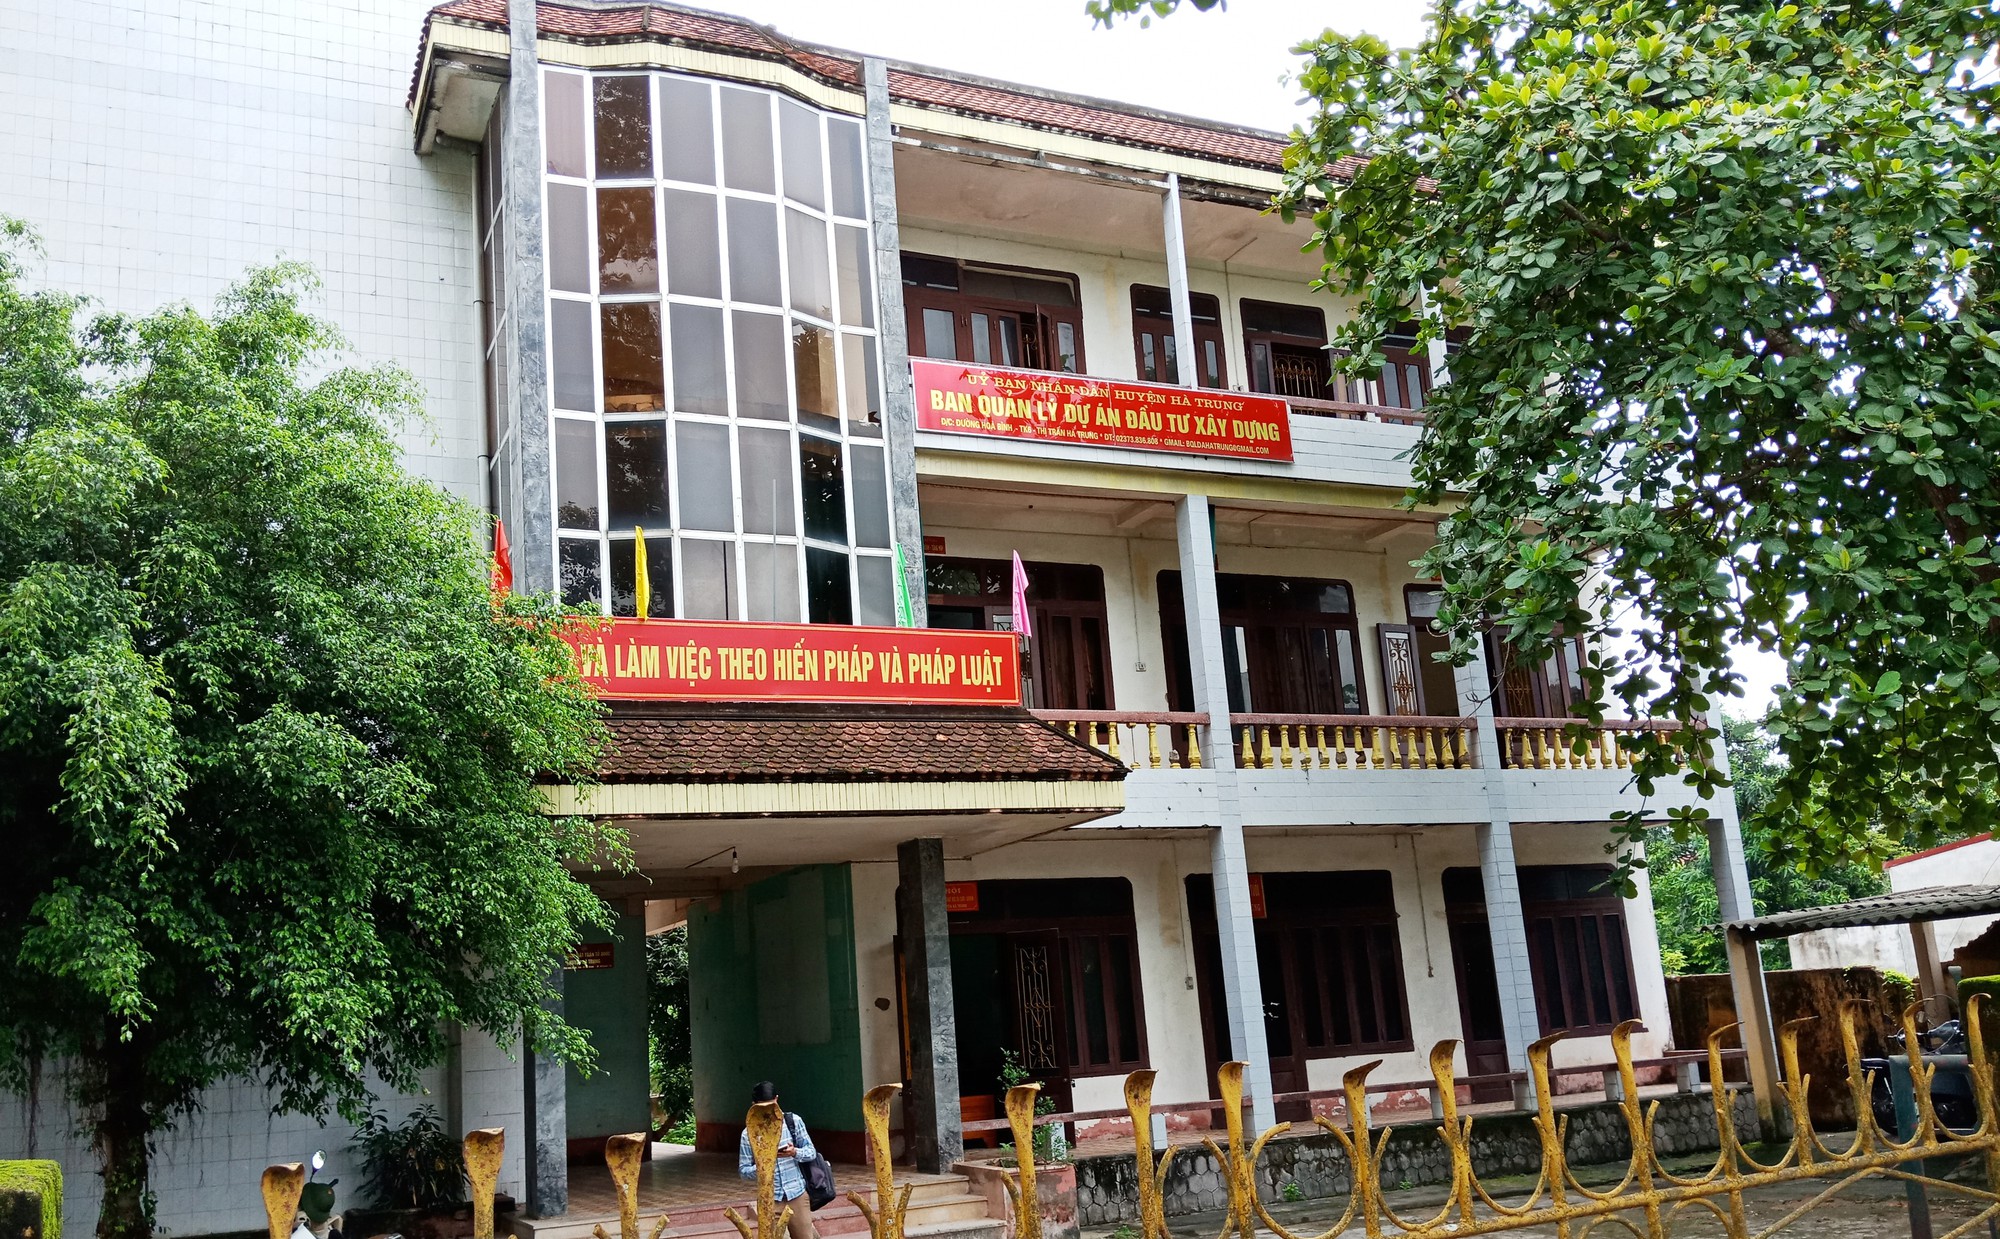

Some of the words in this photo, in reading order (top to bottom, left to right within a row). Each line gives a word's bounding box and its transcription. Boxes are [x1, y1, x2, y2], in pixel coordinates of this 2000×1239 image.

[966, 372, 989, 386] UỶ
[994, 376, 1026, 390] BAN
[1030, 379, 1075, 395] NHÂN
[1079, 383, 1109, 398] DÂN
[1114, 390, 1166, 405] HUYỆN
[1170, 392, 1192, 406] HÀ
[1194, 398, 1243, 411] TRUNG
[930, 389, 972, 414] BAN
[977, 389, 1032, 419] QUẢN
[1036, 397, 1058, 422] LÝ
[1064, 402, 1091, 428] DỰ
[1095, 402, 1121, 428] ÁN
[1125, 404, 1162, 431] ĐẦU
[1166, 412, 1191, 434] TƯ
[1195, 413, 1228, 437] XÂY
[1232, 419, 1280, 443] DỰNG
[1077, 430, 1098, 439] TRUNG
[614, 637, 660, 679] LÀM
[665, 639, 712, 687] VIỆC
[717, 646, 768, 681] THEO
[773, 637, 819, 681] HIẾN
[824, 644, 874, 683] PHÁP
[879, 645, 904, 684] VÀ
[908, 647, 956, 685] PHÁP
[960, 649, 1003, 692] LUẬT
